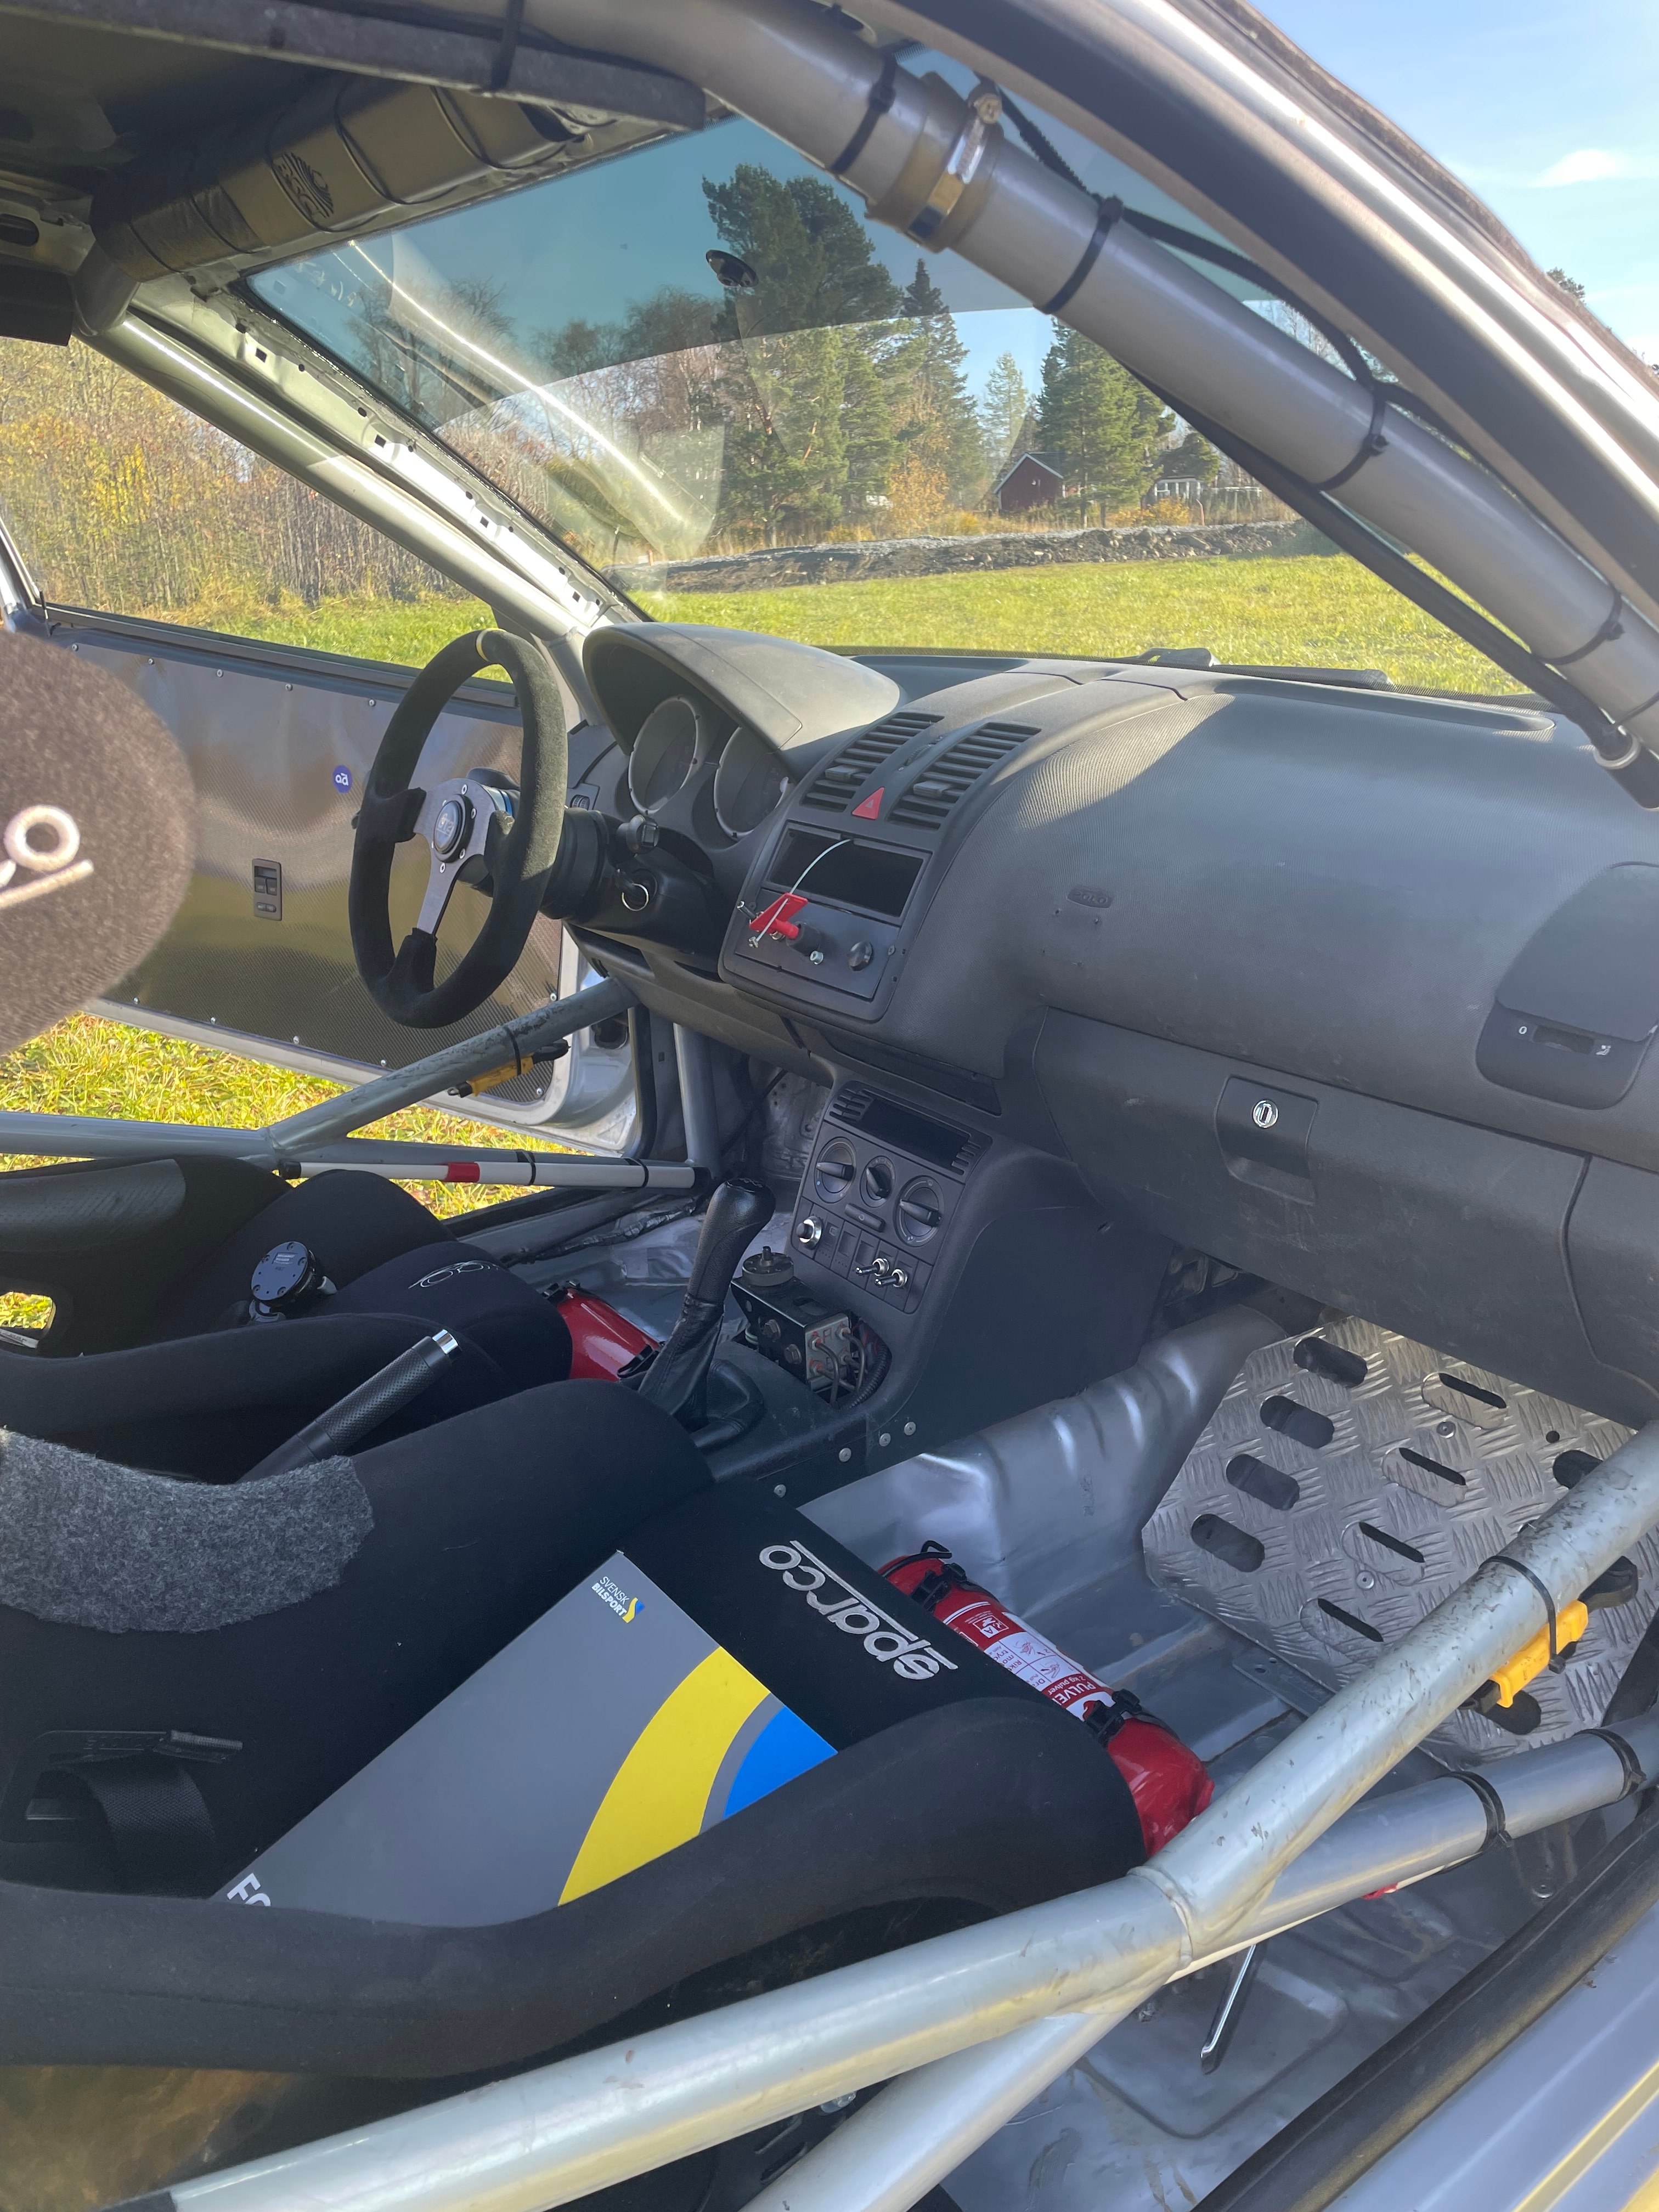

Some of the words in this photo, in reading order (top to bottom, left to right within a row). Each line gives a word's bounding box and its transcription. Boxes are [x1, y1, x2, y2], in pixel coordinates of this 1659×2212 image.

[591, 1582, 628, 1616] BILSPORT
[600, 1576, 630, 1605] SVENSK
[759, 1540, 958, 1680] sparco
[1047, 1679, 1070, 1695] pulver
